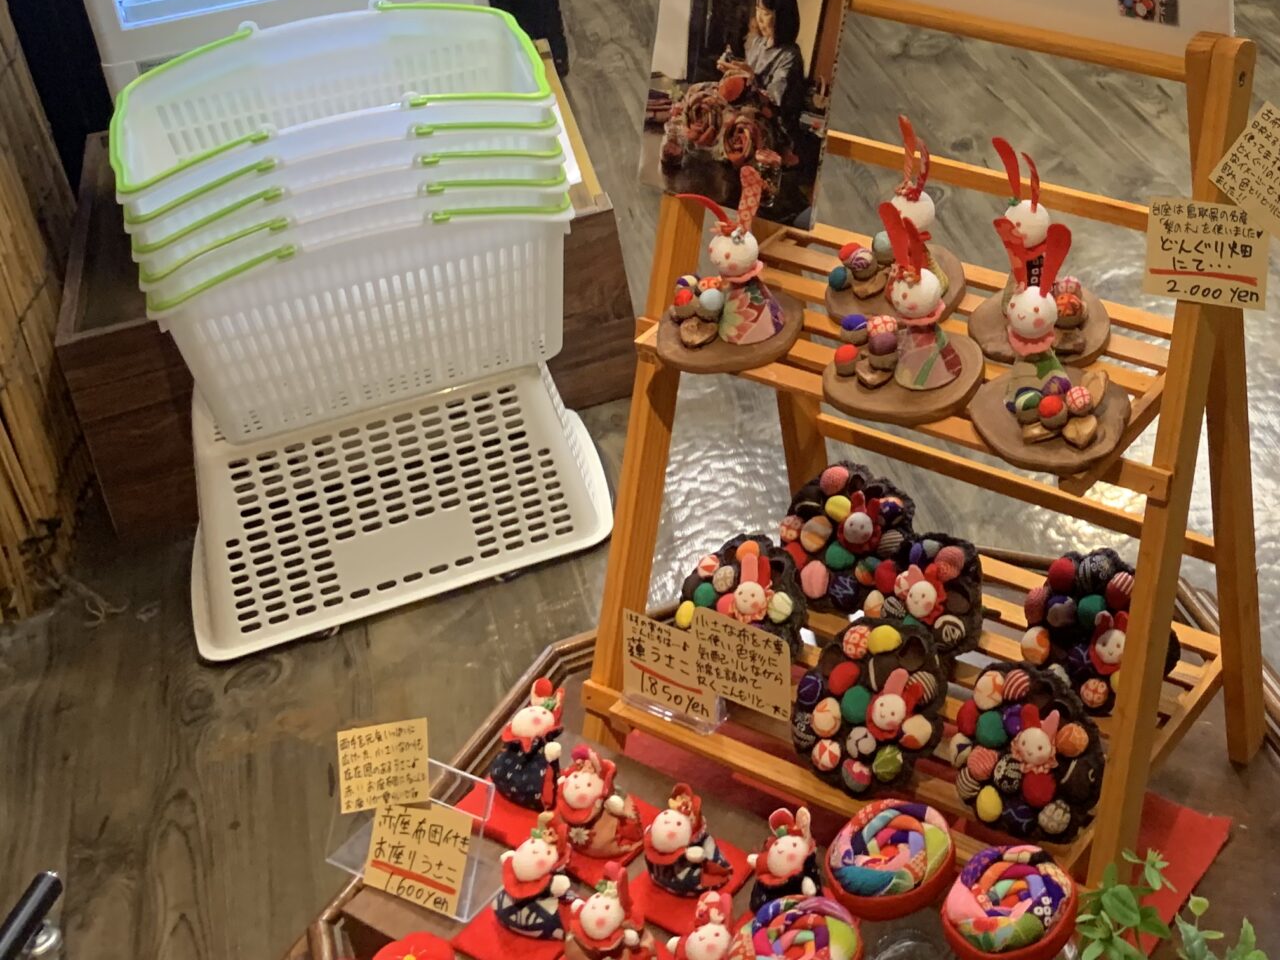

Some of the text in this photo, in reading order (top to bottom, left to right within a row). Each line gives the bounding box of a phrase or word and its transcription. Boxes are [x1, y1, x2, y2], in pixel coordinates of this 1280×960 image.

[1160, 236, 1253, 259] どんぐり畑
